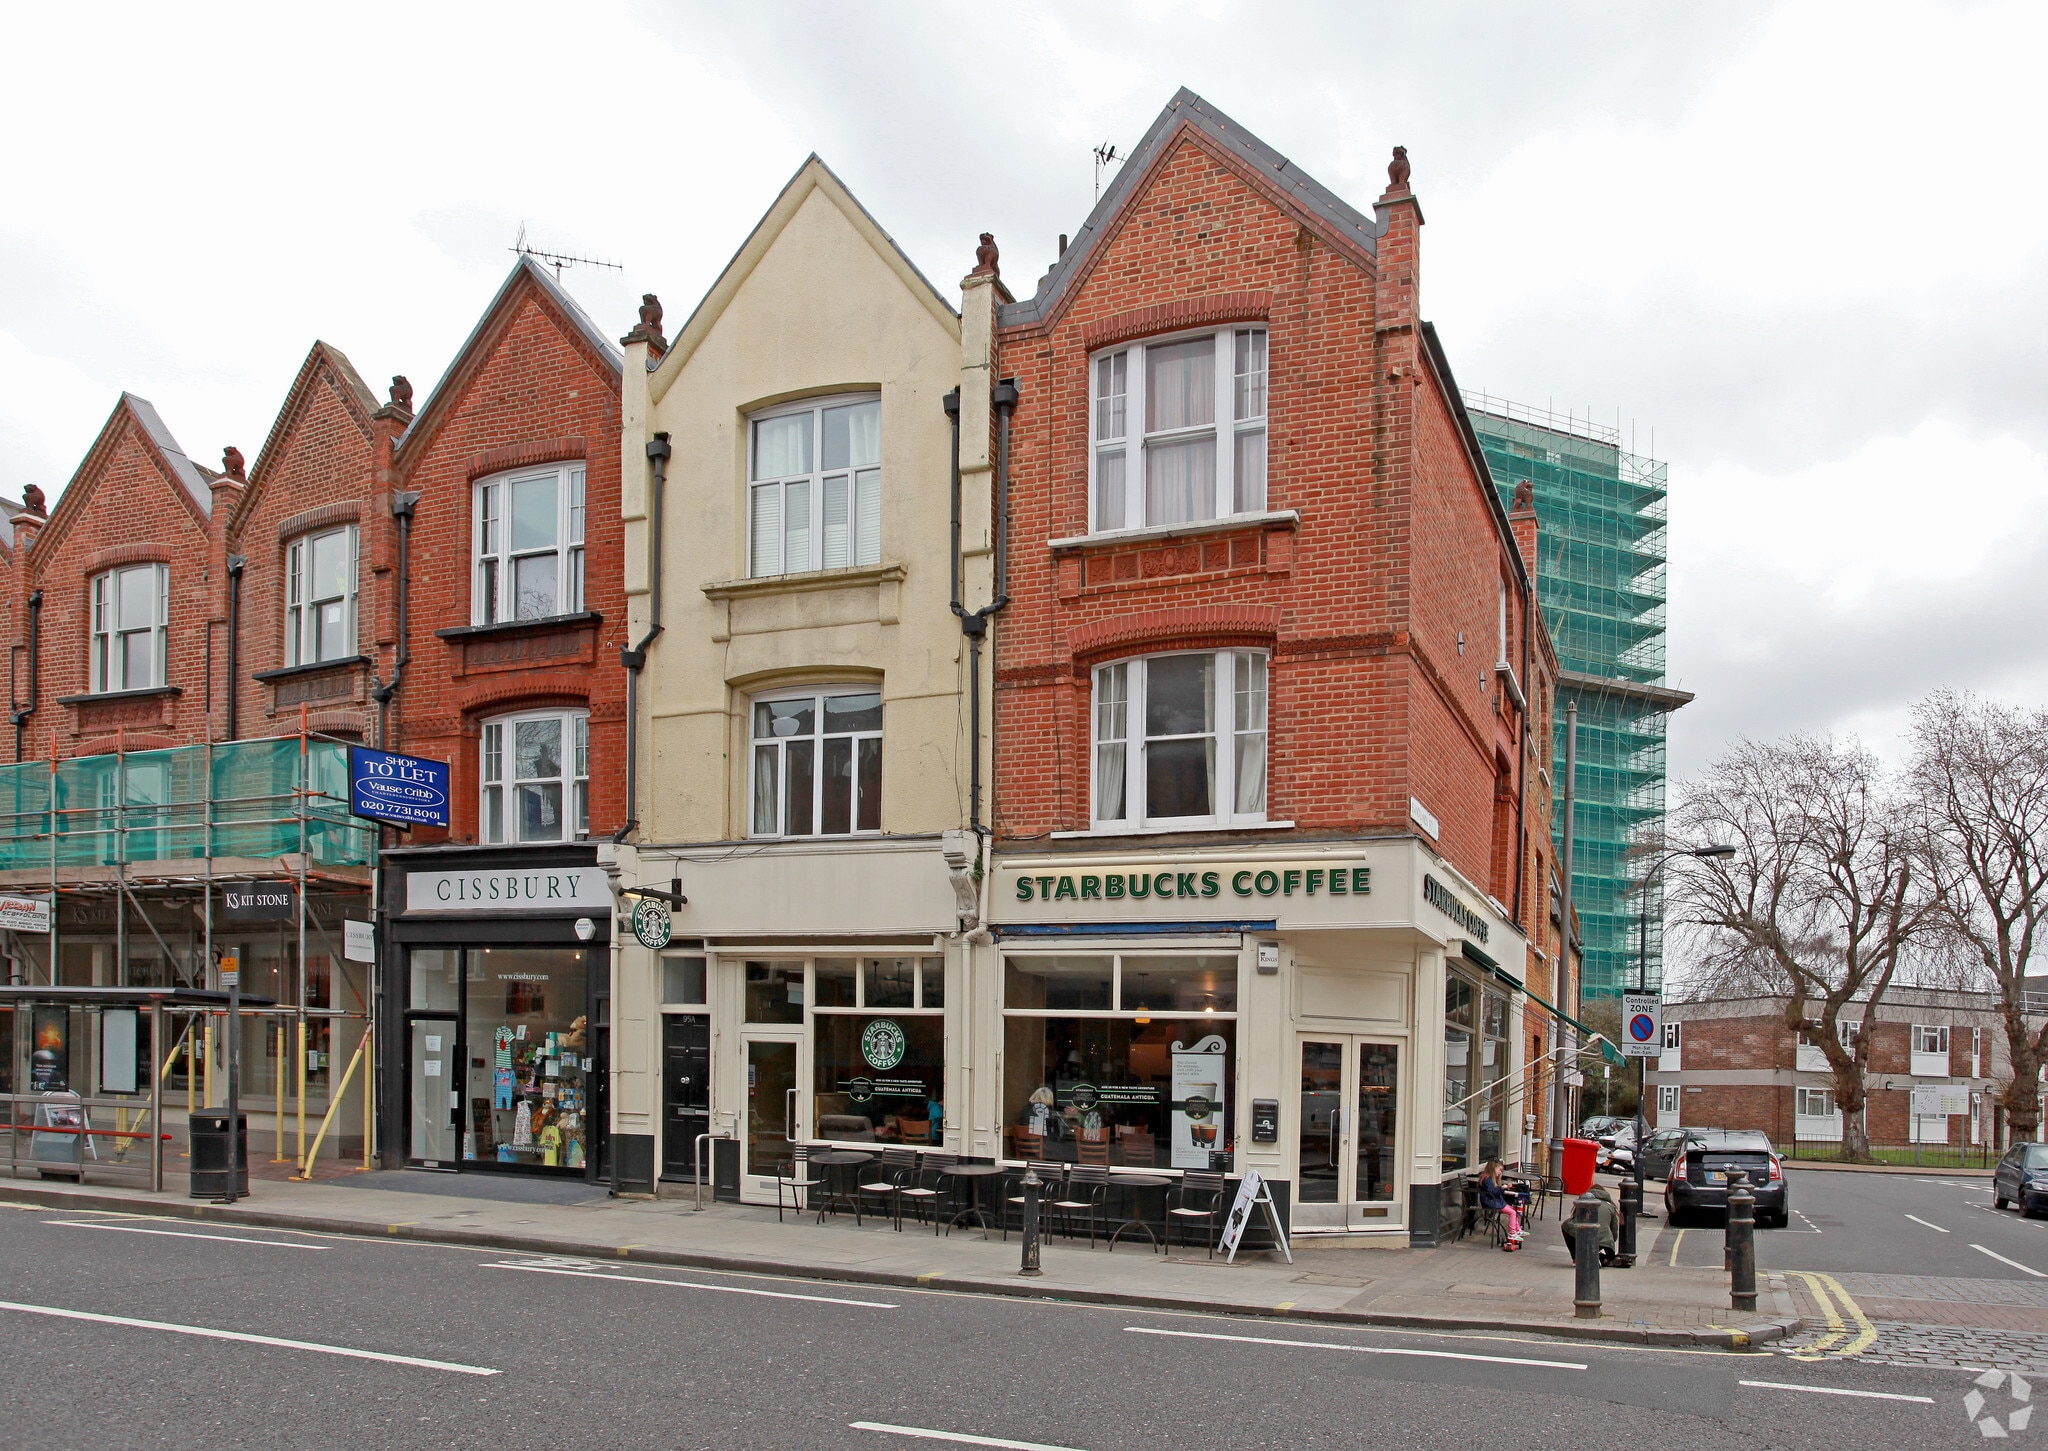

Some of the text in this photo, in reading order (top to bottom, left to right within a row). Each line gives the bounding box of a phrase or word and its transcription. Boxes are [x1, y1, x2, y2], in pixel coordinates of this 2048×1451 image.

[385, 756, 417, 767] SHOP
[364, 761, 438, 783] TO LET
[368, 781, 433, 799] Vause Cribb
[361, 800, 440, 820] 020 7731 8001
[437, 875, 581, 901] CISSBURY
[1015, 867, 1372, 901] STARBUCKS COFFEE
[0, 900, 36, 912] RBAN
[226, 893, 289, 909] KS KIT STONE
[1, 910, 47, 920] SCAFFOLDING
[637, 901, 670, 924] STARBUCKS
[1424, 873, 1489, 945] STARBUCKS COFFEE
[641, 932, 667, 947] COFFEE
[497, 972, 550, 982] www.cissbury.com
[1625, 996, 1659, 1005] Controlled
[1630, 1004, 1654, 1013] ZONE
[682, 1015, 696, 1023] 95A
[865, 1021, 903, 1043] STARBUCKS
[868, 1053, 898, 1067] COFFEE
